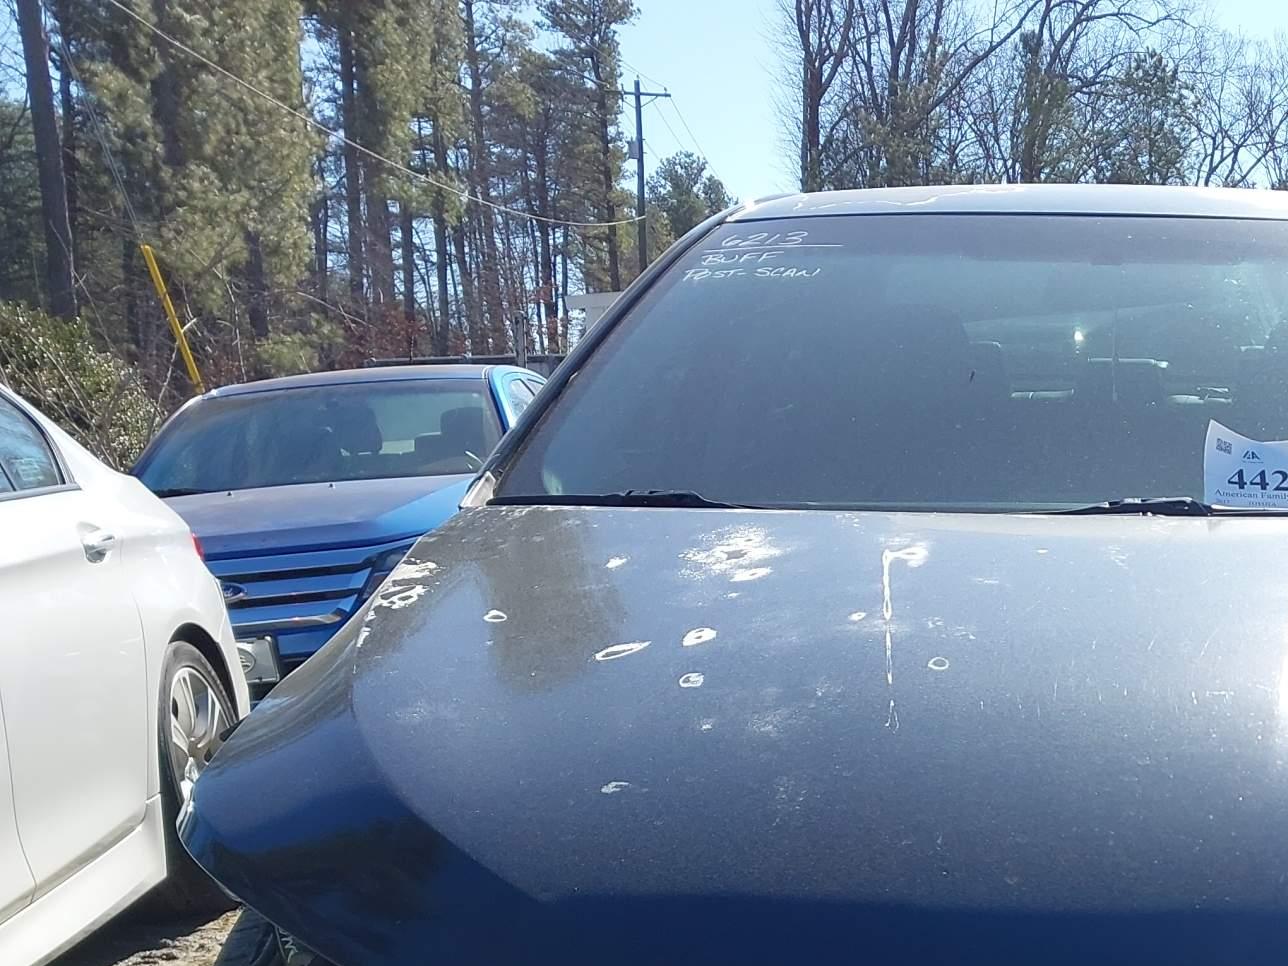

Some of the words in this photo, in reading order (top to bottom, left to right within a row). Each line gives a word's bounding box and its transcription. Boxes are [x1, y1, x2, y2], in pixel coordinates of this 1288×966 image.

[721, 230, 809, 247] 6213
[701, 250, 785, 266] BUFF
[754, 266, 821, 278] SCAN
[1215, 488, 1258, 499] American
